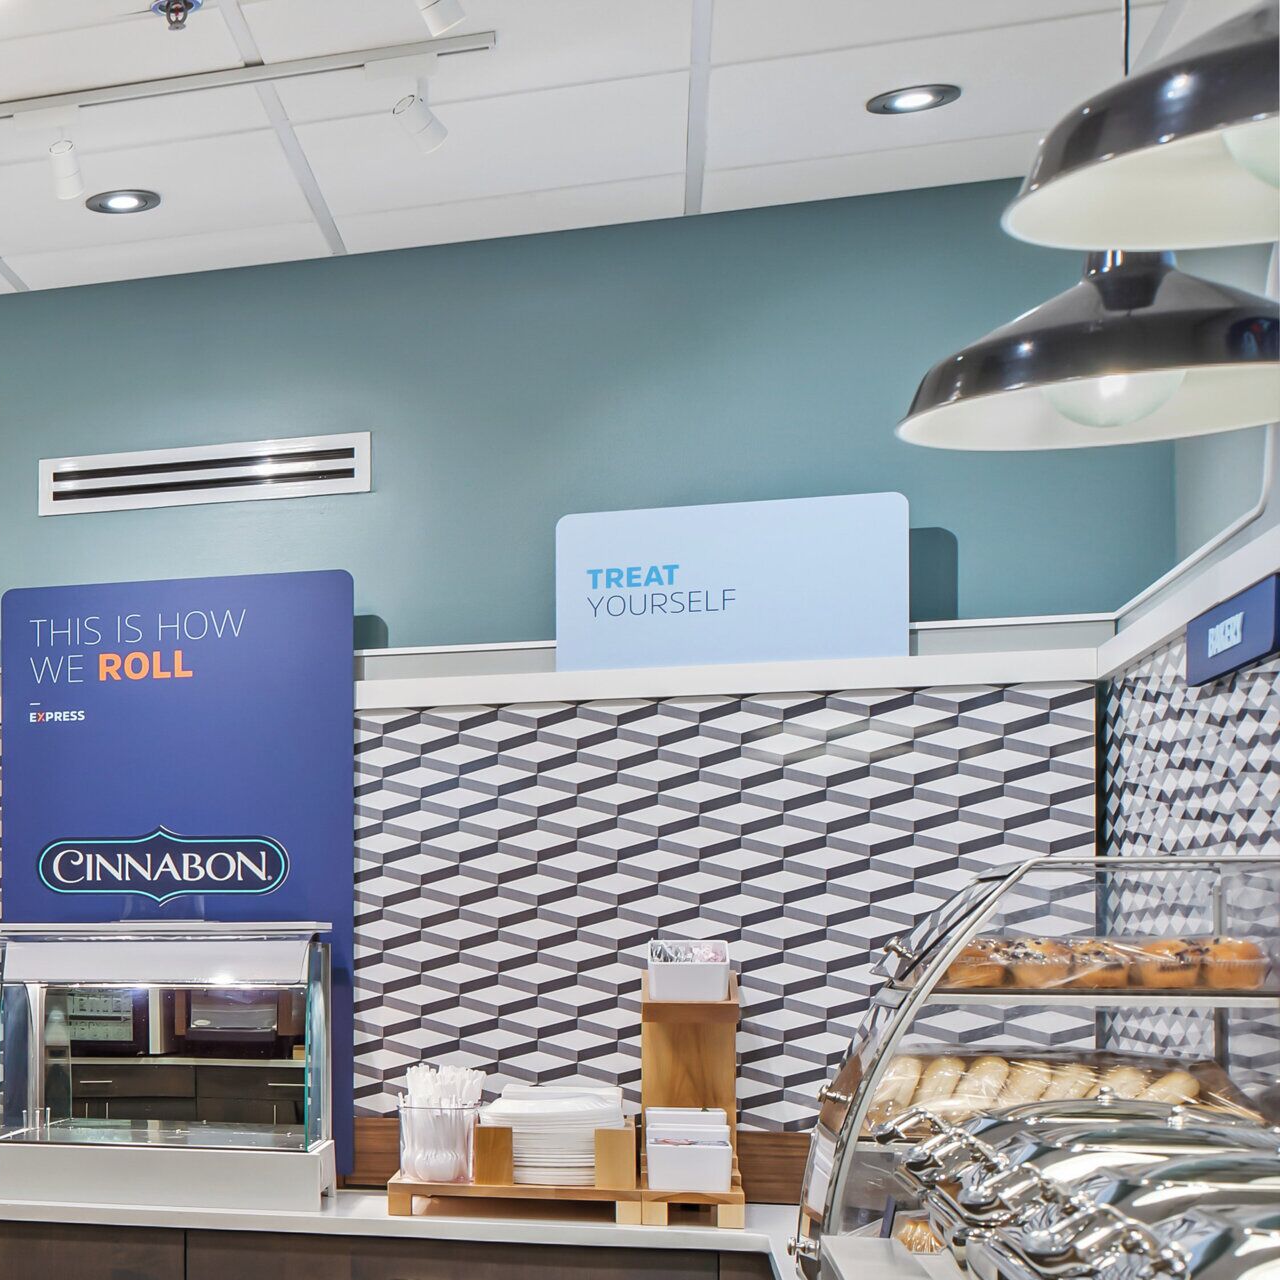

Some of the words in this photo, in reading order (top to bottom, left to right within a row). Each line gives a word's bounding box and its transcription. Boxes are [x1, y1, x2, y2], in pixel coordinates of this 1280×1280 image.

[586, 564, 680, 590] TREAT
[586, 588, 737, 618] YOURSELF
[29, 615, 102, 648] THIS
[115, 613, 143, 645] IS
[157, 608, 247, 642] HOW
[29, 653, 85, 684] WE
[98, 649, 194, 682] ROLL
[29, 709, 86, 724] EXPRESS
